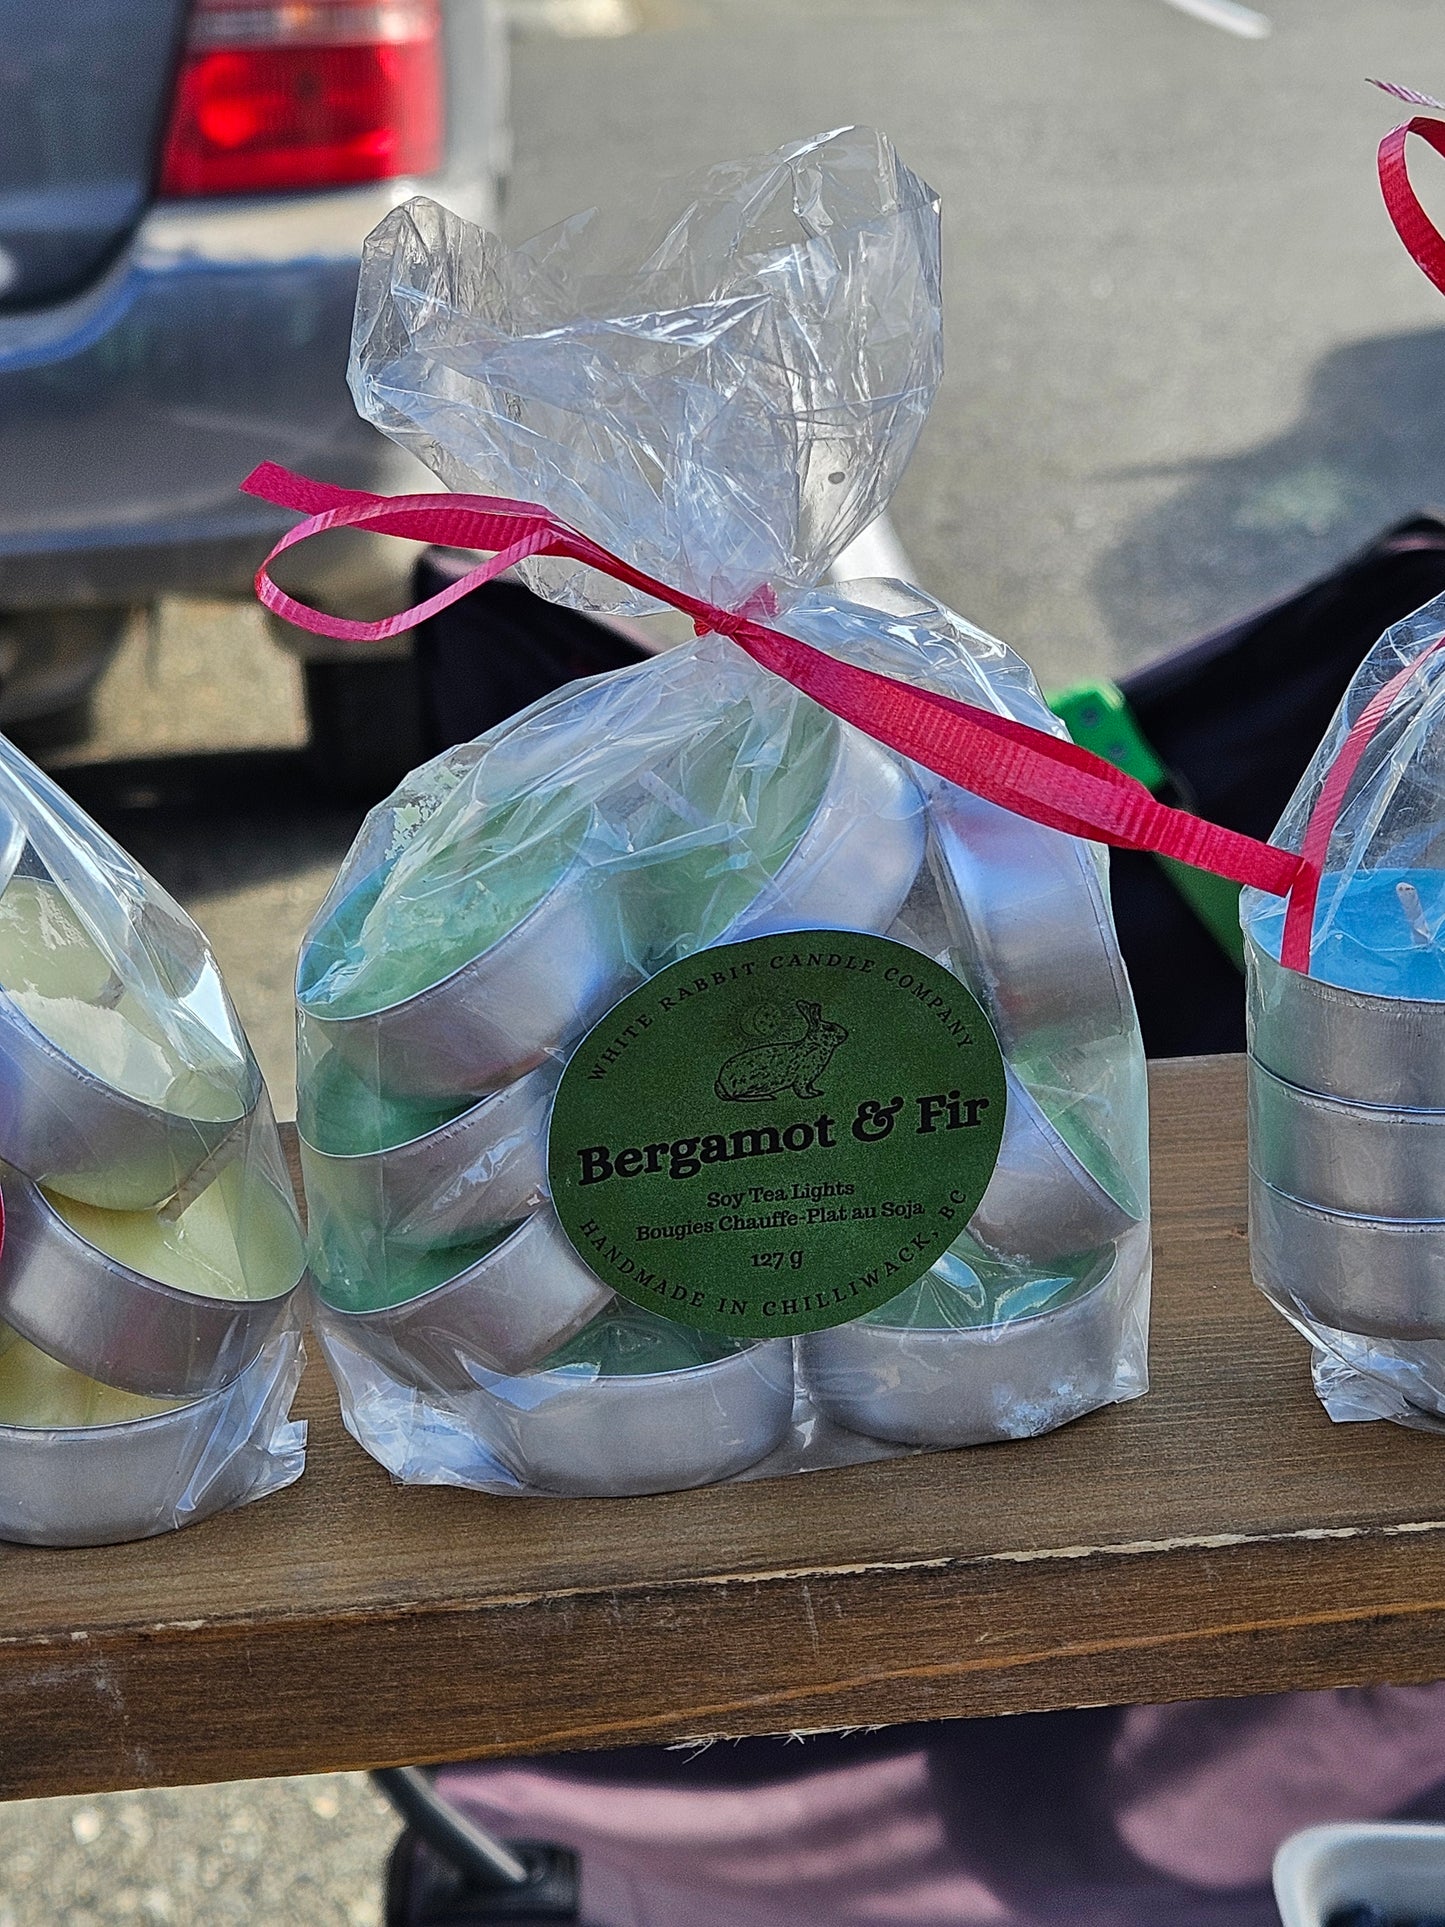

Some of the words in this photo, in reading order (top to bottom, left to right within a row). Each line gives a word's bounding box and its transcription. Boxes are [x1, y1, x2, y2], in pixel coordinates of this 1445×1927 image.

[587, 1013, 654, 1082] WHITE
[661, 962, 756, 1012] RABBIT
[770, 953, 876, 974] CANDLE
[883, 967, 974, 1050] COMPANY
[577, 1113, 836, 1185] Bergamot
[852, 1096, 904, 1143] &
[916, 1090, 989, 1134] Fir
[636, 1217, 714, 1242] Bougies
[719, 1206, 847, 1231] Chauffe-Plat
[851, 1205, 877, 1219] au
[881, 1200, 925, 1219] Soja
[707, 1191, 744, 1210] Soy
[749, 1187, 787, 1203] Tea
[790, 1181, 854, 1202] Lights
[579, 1218, 705, 1308] HANDMADE
[717, 1299, 746, 1315] IN
[762, 1231, 939, 1317] CHILLIWACK,
[937, 1189, 967, 1222] BC
[750, 1252, 783, 1269] 127
[788, 1250, 804, 1270] g
